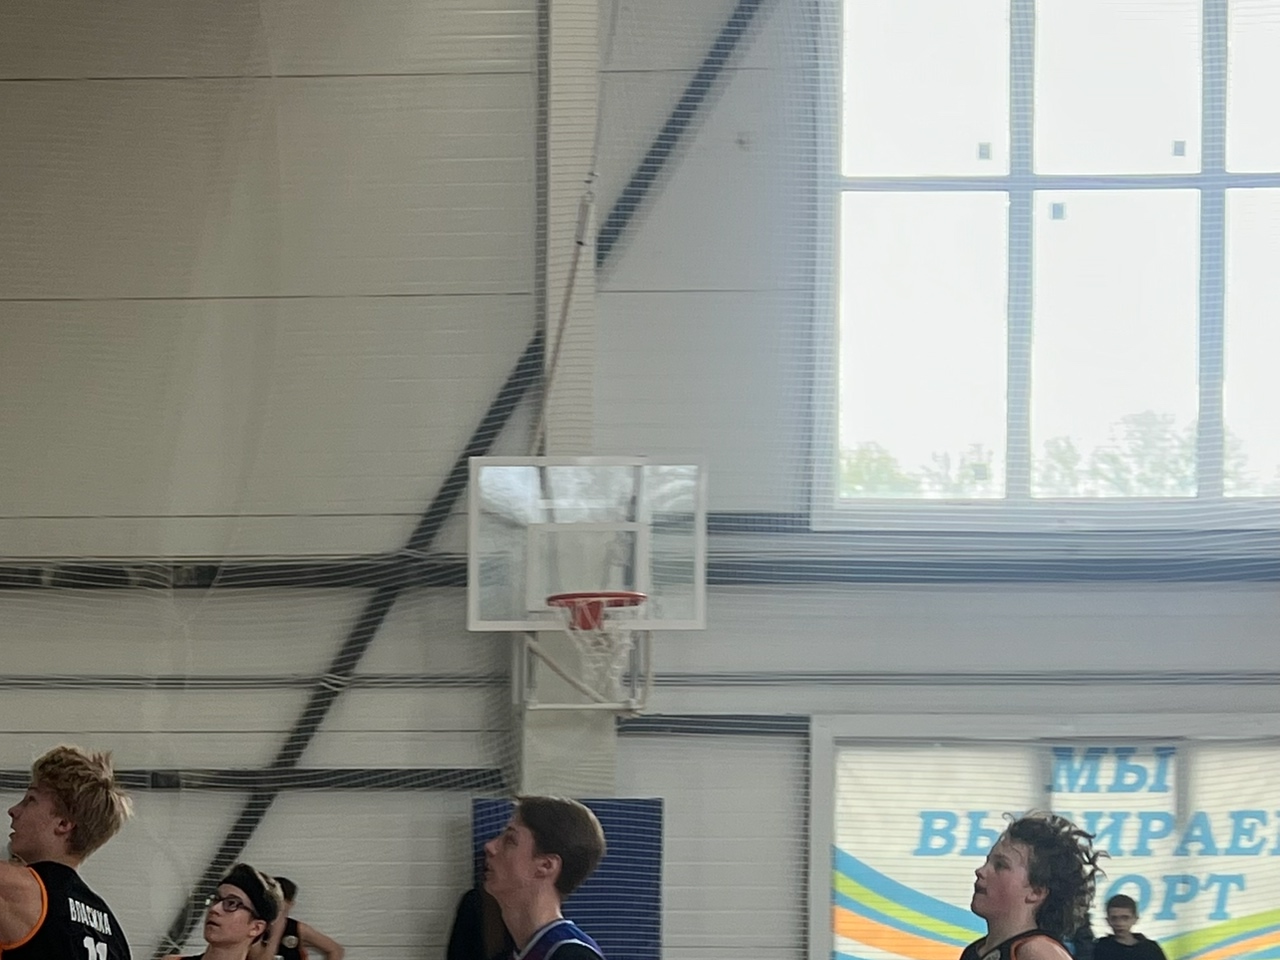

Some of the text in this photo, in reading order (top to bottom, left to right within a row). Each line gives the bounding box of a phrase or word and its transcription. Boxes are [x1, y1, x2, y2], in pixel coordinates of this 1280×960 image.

[1051, 747, 1177, 793] МЫ
[913, 810, 1280, 857] ВЫИРАЕ
[1096, 873, 1246, 921] ОРТ
